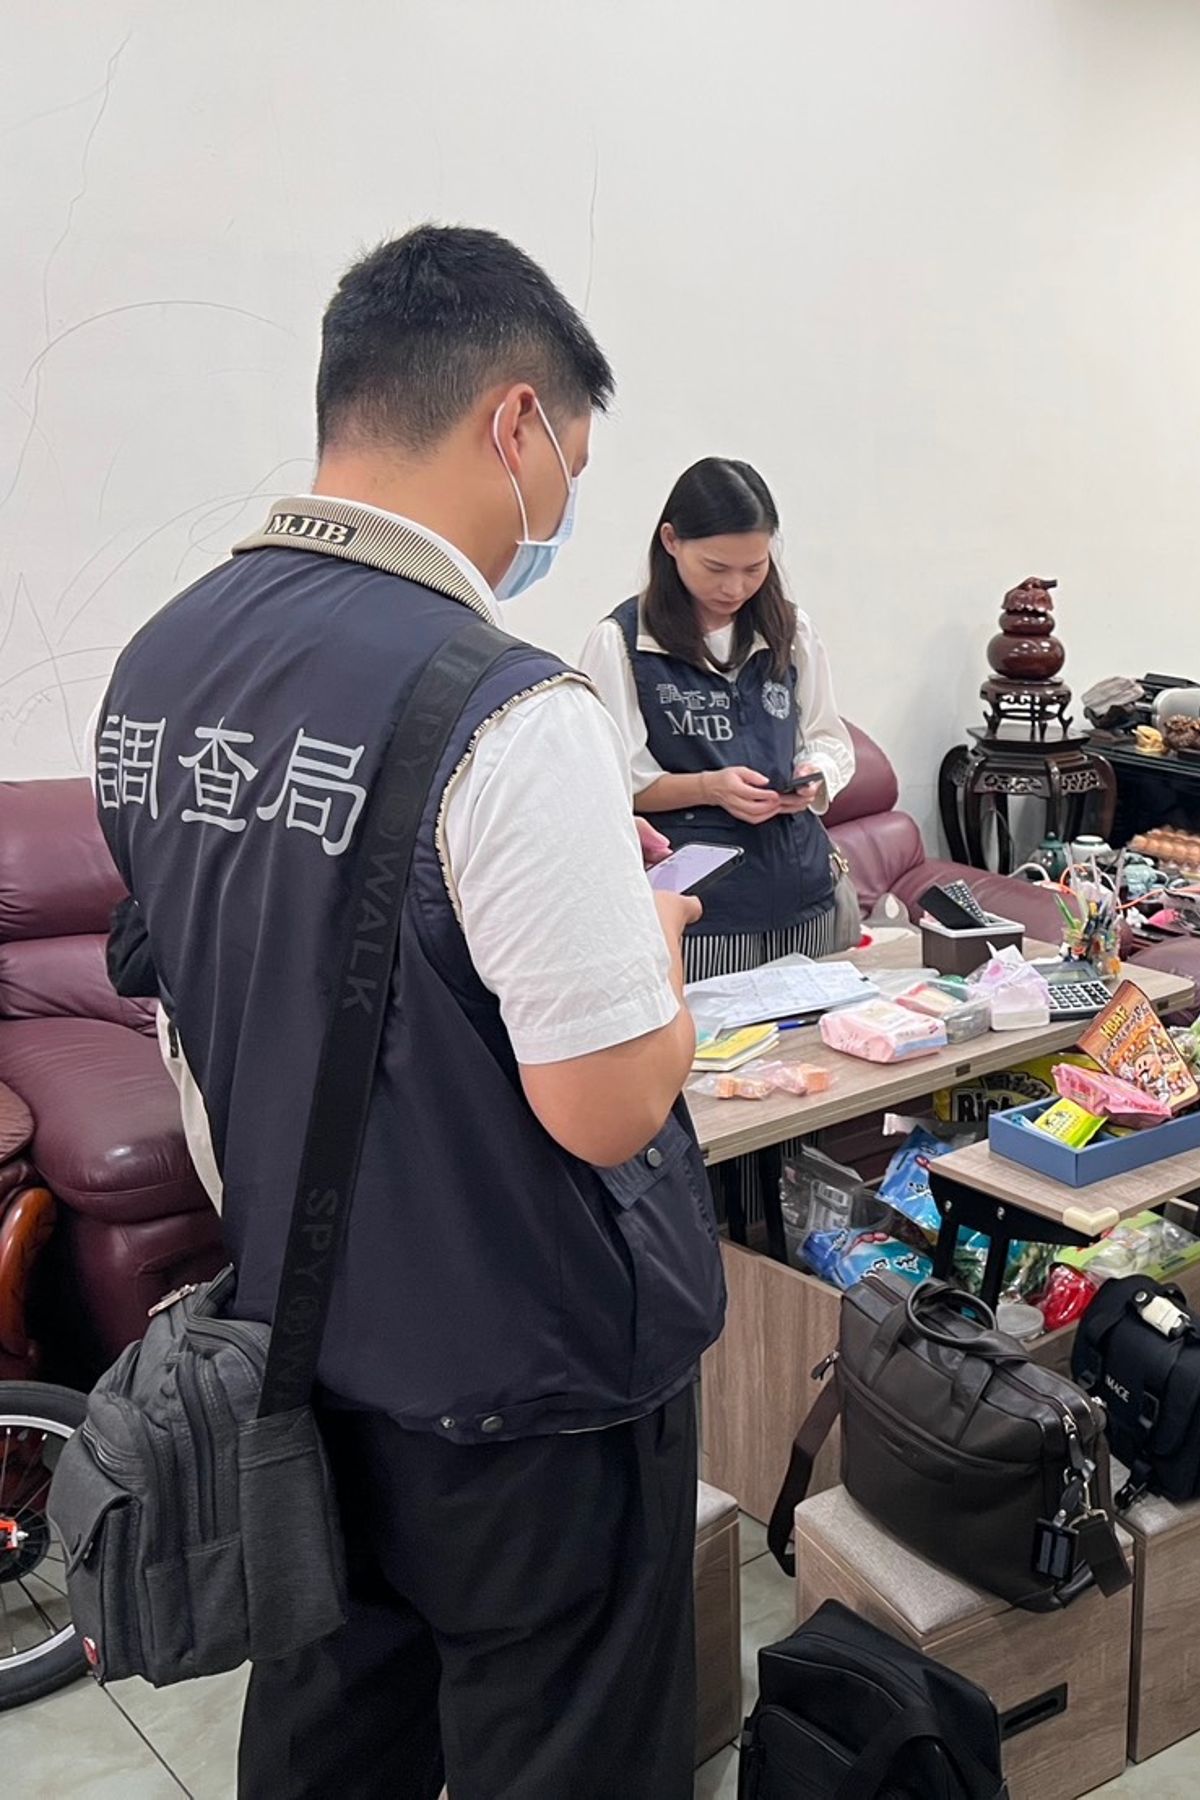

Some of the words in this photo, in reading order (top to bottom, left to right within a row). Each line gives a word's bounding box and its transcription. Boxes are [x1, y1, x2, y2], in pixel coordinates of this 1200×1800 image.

[266, 515, 348, 544] MJIB
[656, 683, 731, 710] 調查局
[664, 710, 734, 742] MJIB
[97, 714, 367, 857] 調查局
